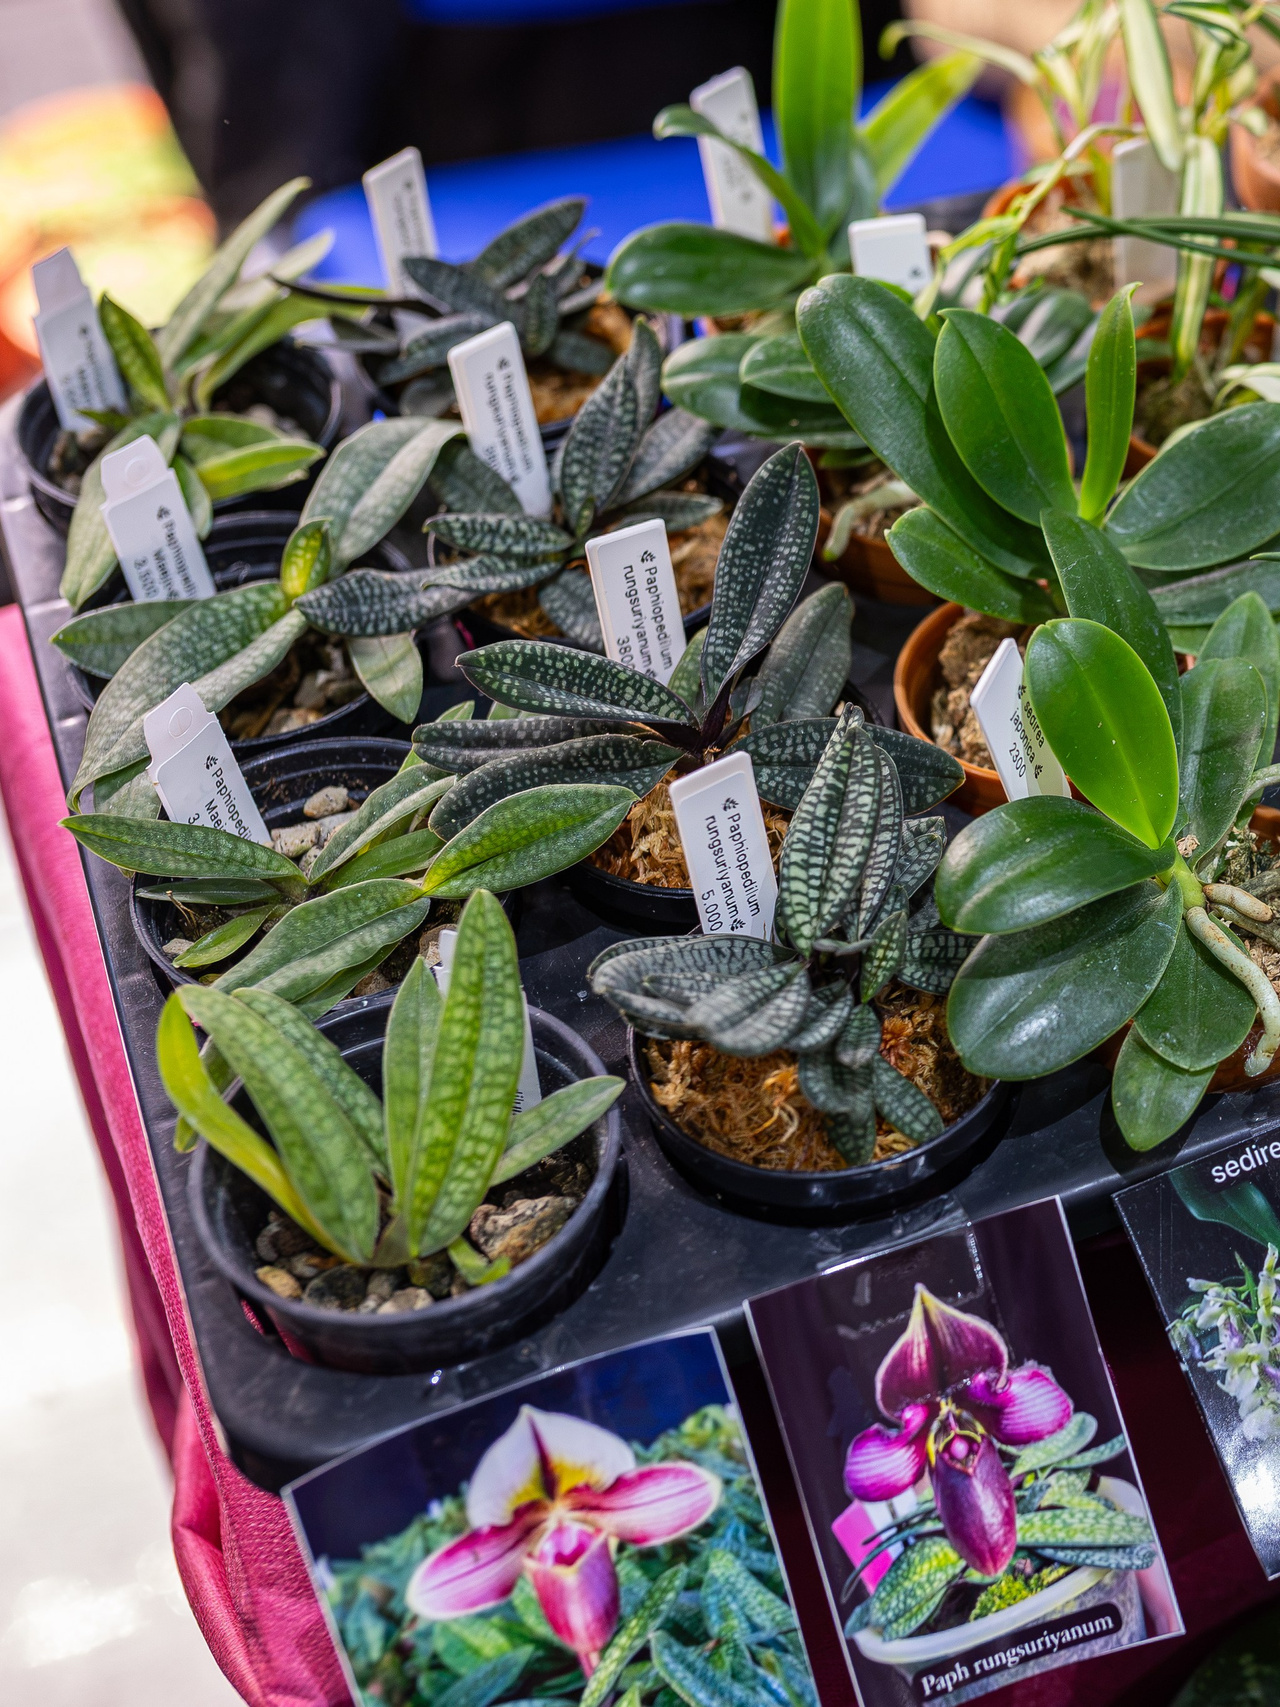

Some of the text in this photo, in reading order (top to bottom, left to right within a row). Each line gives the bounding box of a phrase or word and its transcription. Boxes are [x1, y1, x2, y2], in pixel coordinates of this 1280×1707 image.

[623, 564, 652, 668] rungsuriyanum
[645, 566, 673, 670] Paphiopedilum
[1009, 742, 1026, 778] 2300
[1010, 708, 1035, 764] japonica
[702, 889, 723, 932] 5.000
[705, 815, 740, 919] rungsuriyanum
[728, 812, 761, 917] Paphiopedilum
[921, 1615, 1114, 1698] Paph rungsuriyanum
